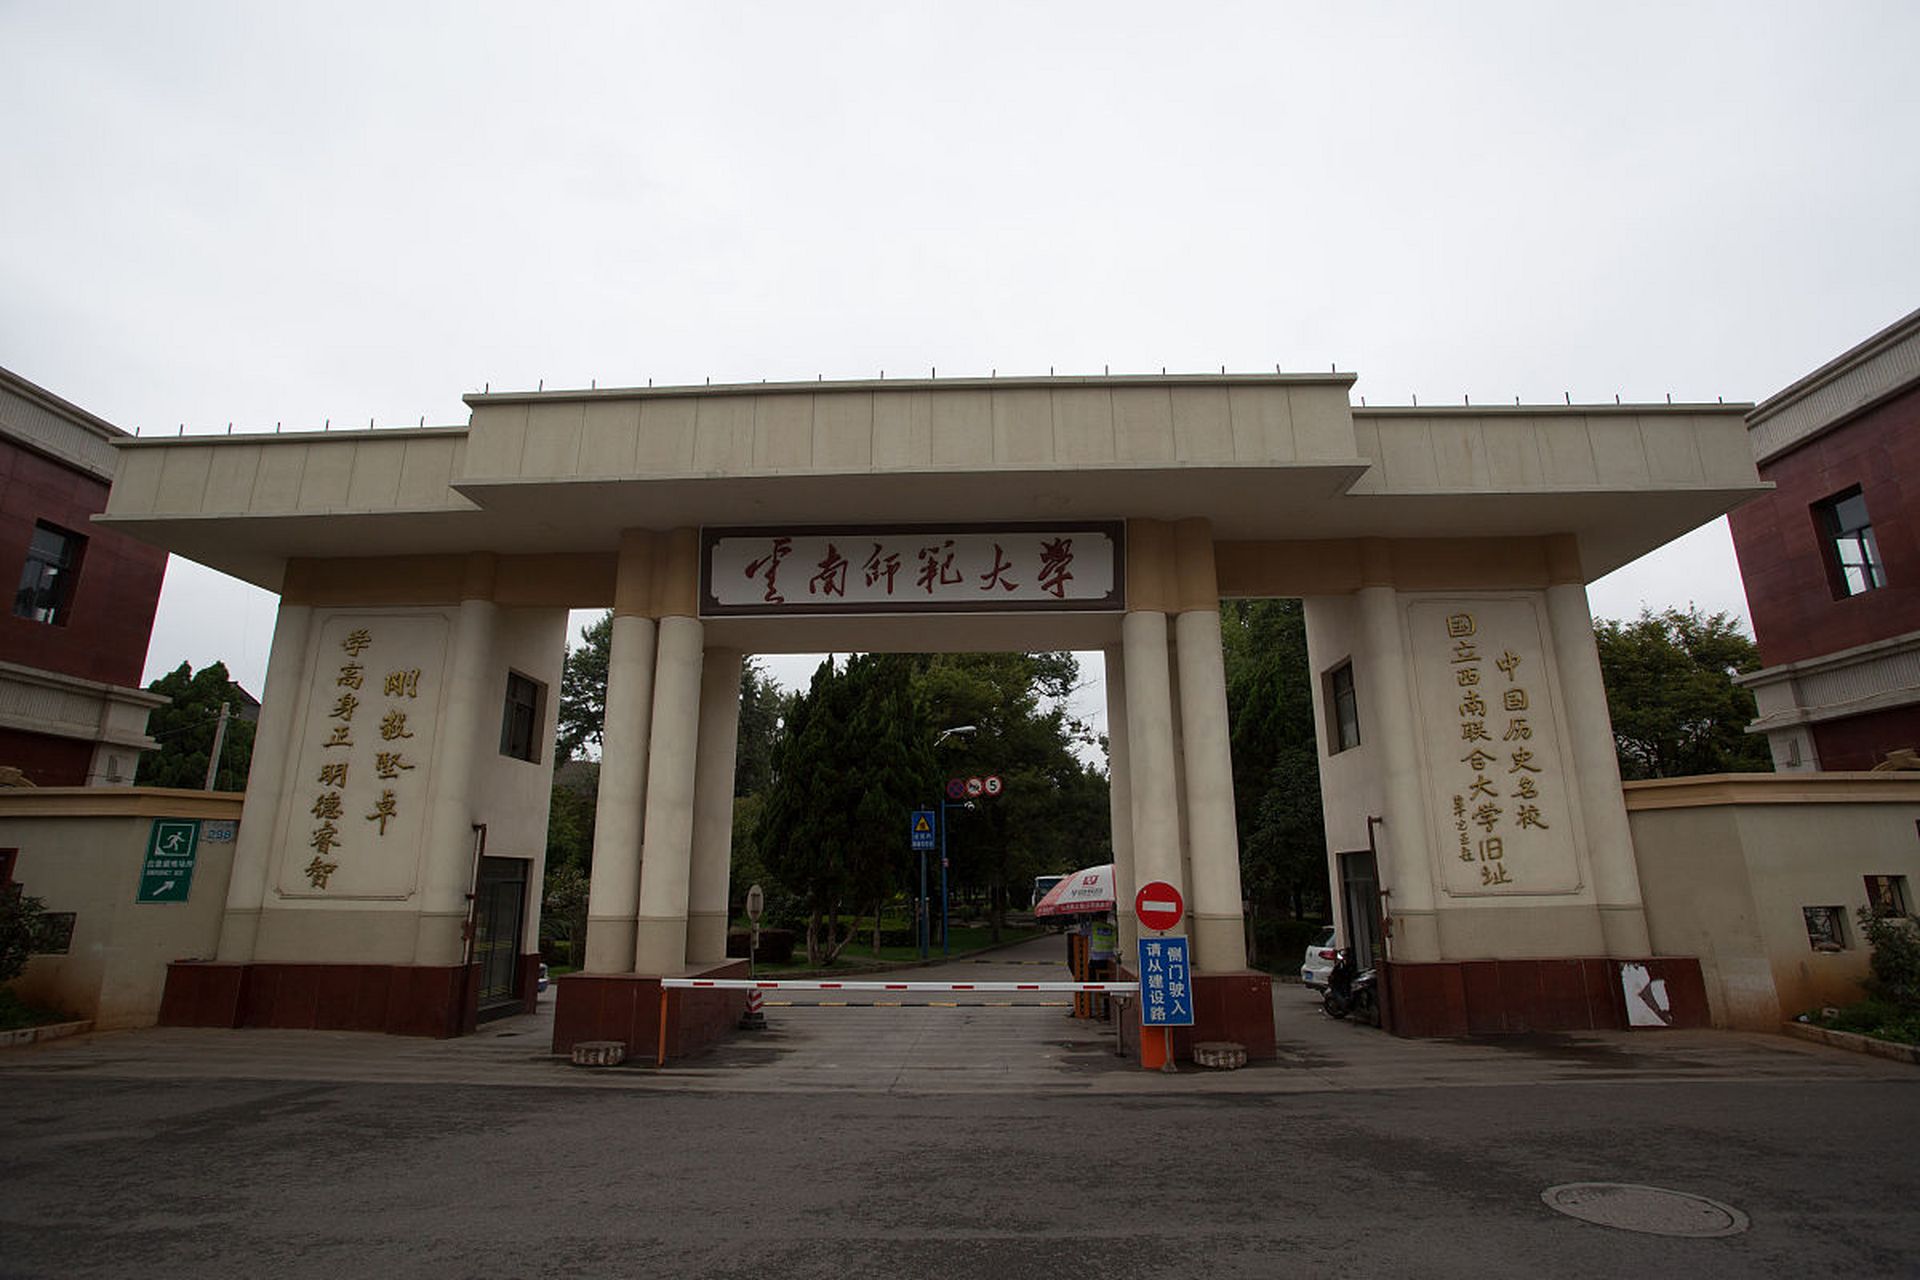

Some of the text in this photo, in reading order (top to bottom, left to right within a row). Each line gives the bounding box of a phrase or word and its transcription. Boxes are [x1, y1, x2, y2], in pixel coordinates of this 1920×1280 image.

[305, 629, 372, 889] 学高身正明德睿智
[1495, 651, 1550, 830] 中国历史名校
[989, 780, 998, 790] 5
[1146, 943, 1166, 1021] 请从建设路
[1167, 947, 1186, 1015] 侧门驶入
